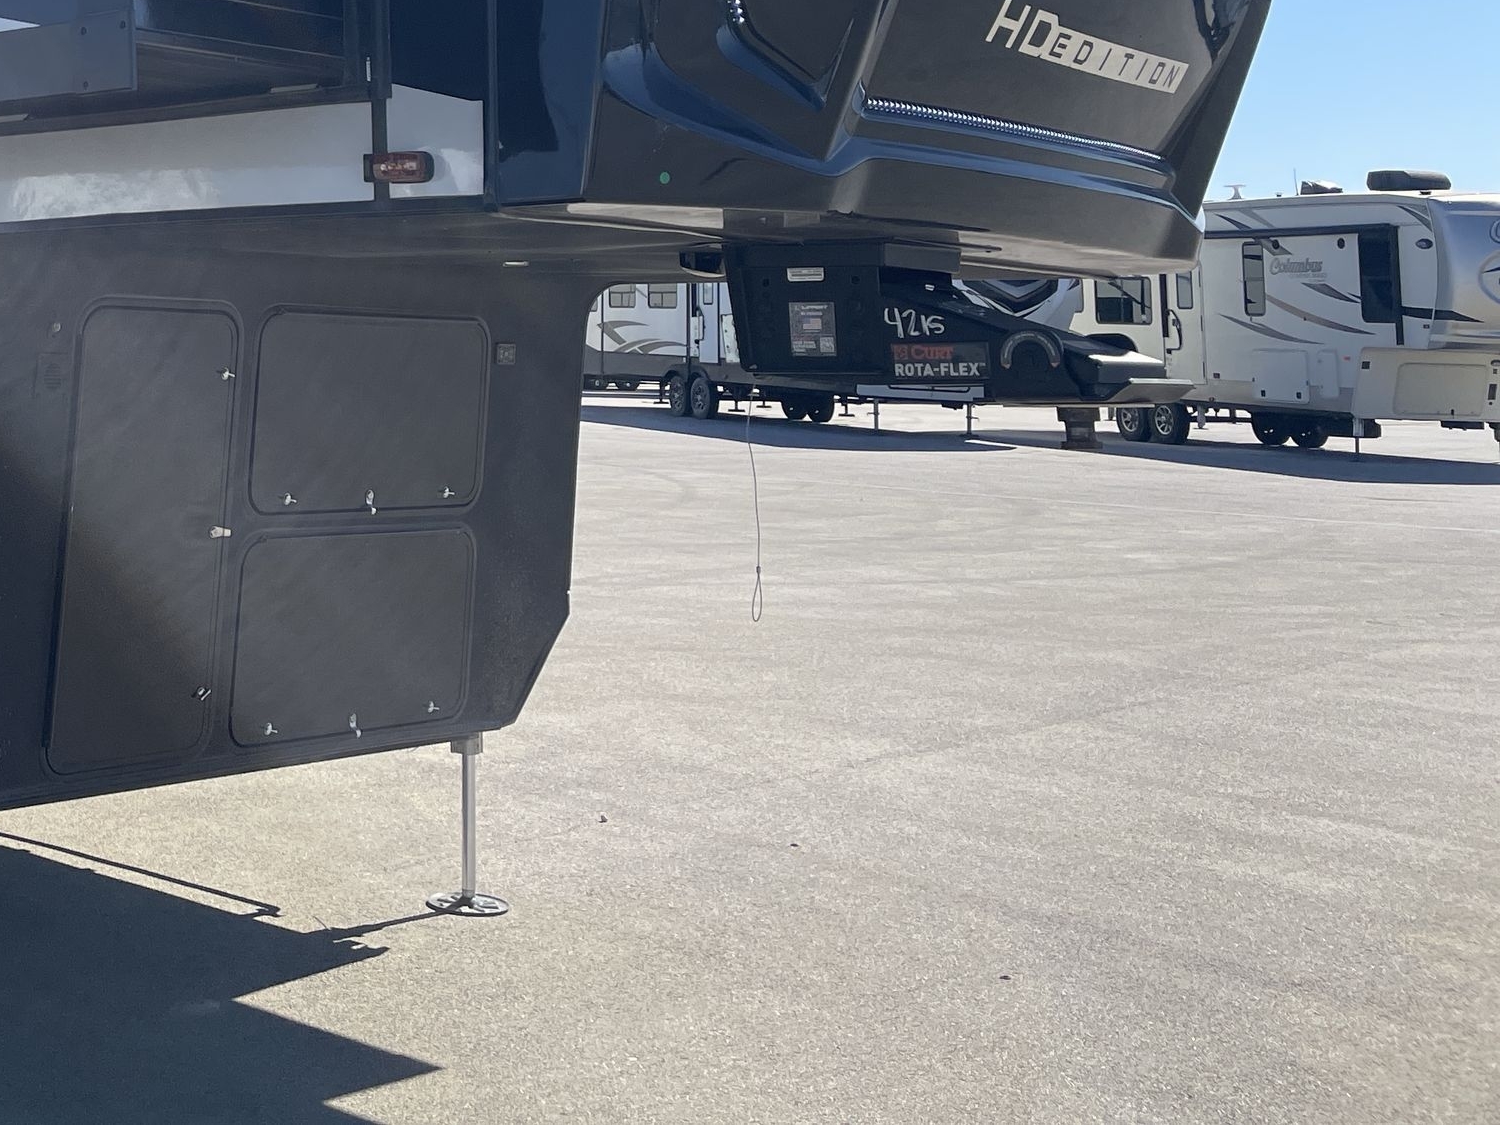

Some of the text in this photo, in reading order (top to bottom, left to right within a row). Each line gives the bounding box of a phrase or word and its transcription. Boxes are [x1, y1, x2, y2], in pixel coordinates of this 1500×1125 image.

[1047, 31, 1184, 91] EDITION
[1269, 257, 1324, 276] Columbus
[910, 344, 954, 360] CURT
